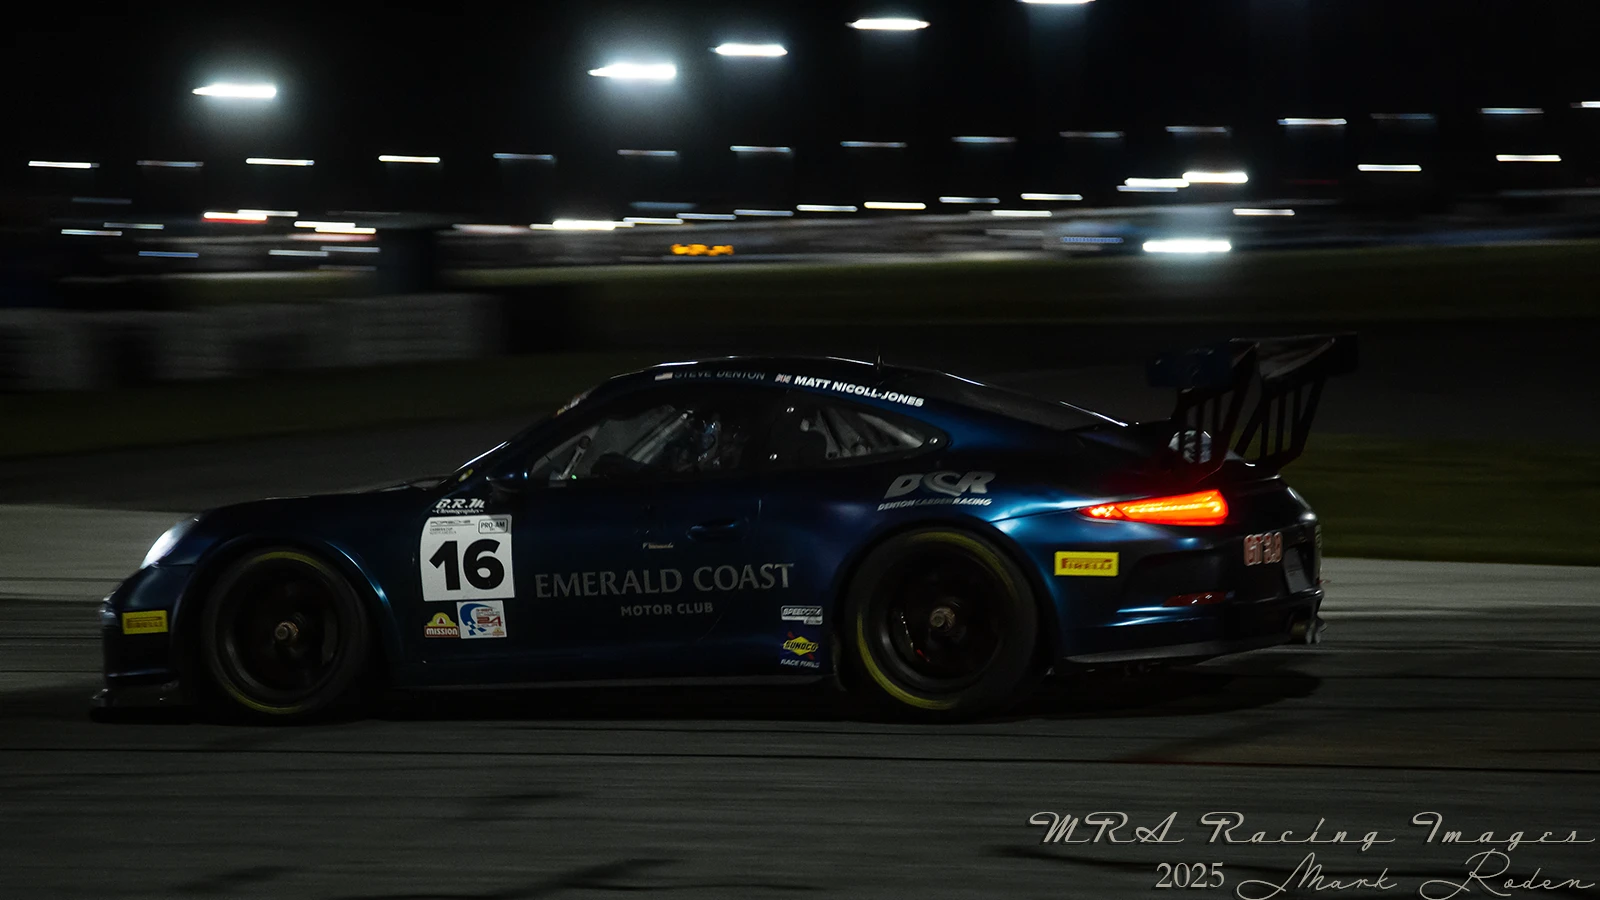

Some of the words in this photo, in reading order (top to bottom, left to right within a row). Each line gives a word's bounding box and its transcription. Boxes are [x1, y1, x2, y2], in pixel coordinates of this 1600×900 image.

[715, 370, 766, 380] DENTON
[793, 375, 832, 390] MATT
[831, 381, 925, 408] NICOLL-JONES
[883, 469, 997, 500] DCR
[429, 538, 505, 591] 16
[534, 567, 683, 599] EMERALD
[692, 562, 795, 592] COAST
[620, 604, 673, 617] MOTOR
[677, 602, 714, 615] CLUB
[785, 641, 818, 651] SUNOCO
